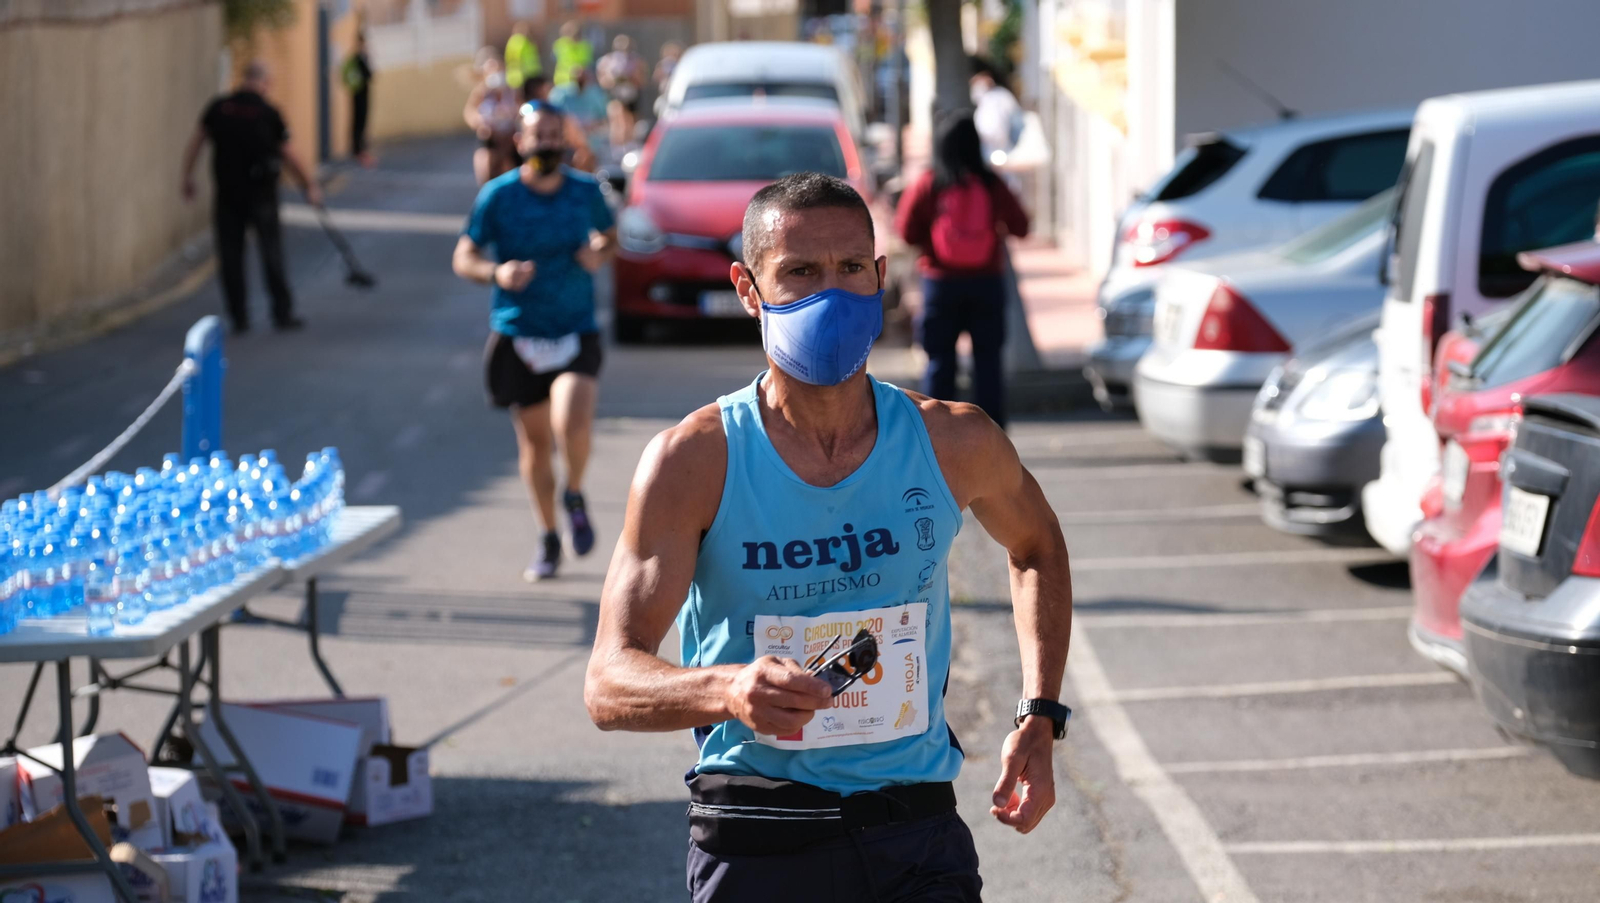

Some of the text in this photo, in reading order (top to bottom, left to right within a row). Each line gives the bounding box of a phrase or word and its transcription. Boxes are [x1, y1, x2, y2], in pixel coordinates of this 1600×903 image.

[742, 523, 900, 573] nerja
[766, 572, 881, 601] ATLETISMO
[804, 622, 853, 642] CIRCUITO
[904, 652, 914, 693] RIOJA
[832, 690, 868, 709] UQUE
